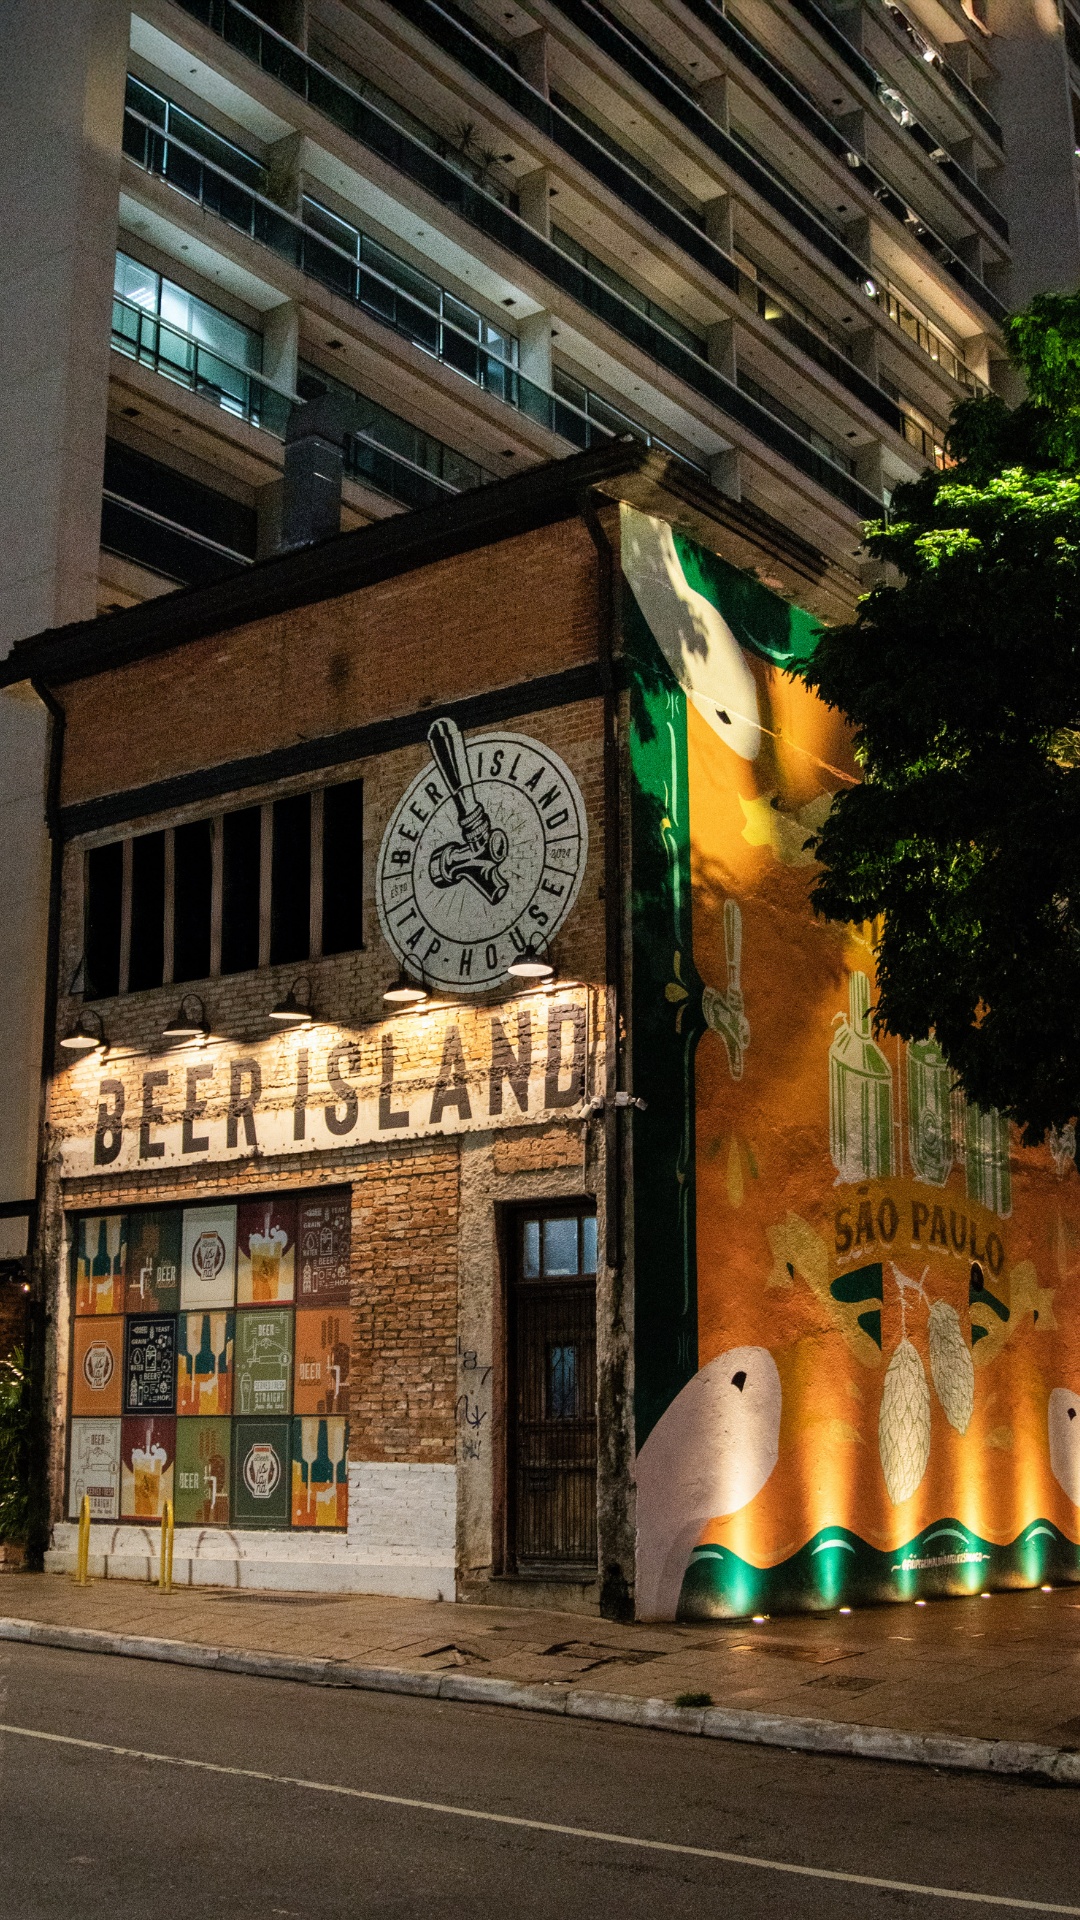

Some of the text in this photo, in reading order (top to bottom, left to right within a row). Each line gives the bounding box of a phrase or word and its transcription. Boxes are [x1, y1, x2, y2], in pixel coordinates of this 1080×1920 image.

[391, 749, 569, 867] BEER ISLAND
[93, 1002, 588, 1167] BEER ISLAND
[834, 1186, 1004, 1276] SÃO PAULO
[156, 1266, 176, 1282] BEER
[258, 1324, 275, 1336] BEER
[300, 1363, 320, 1380] BEER
[254, 1392, 285, 1403] STRAIGHT
[91, 1434, 105, 1446] BEER
[180, 1473, 199, 1489] BEER
